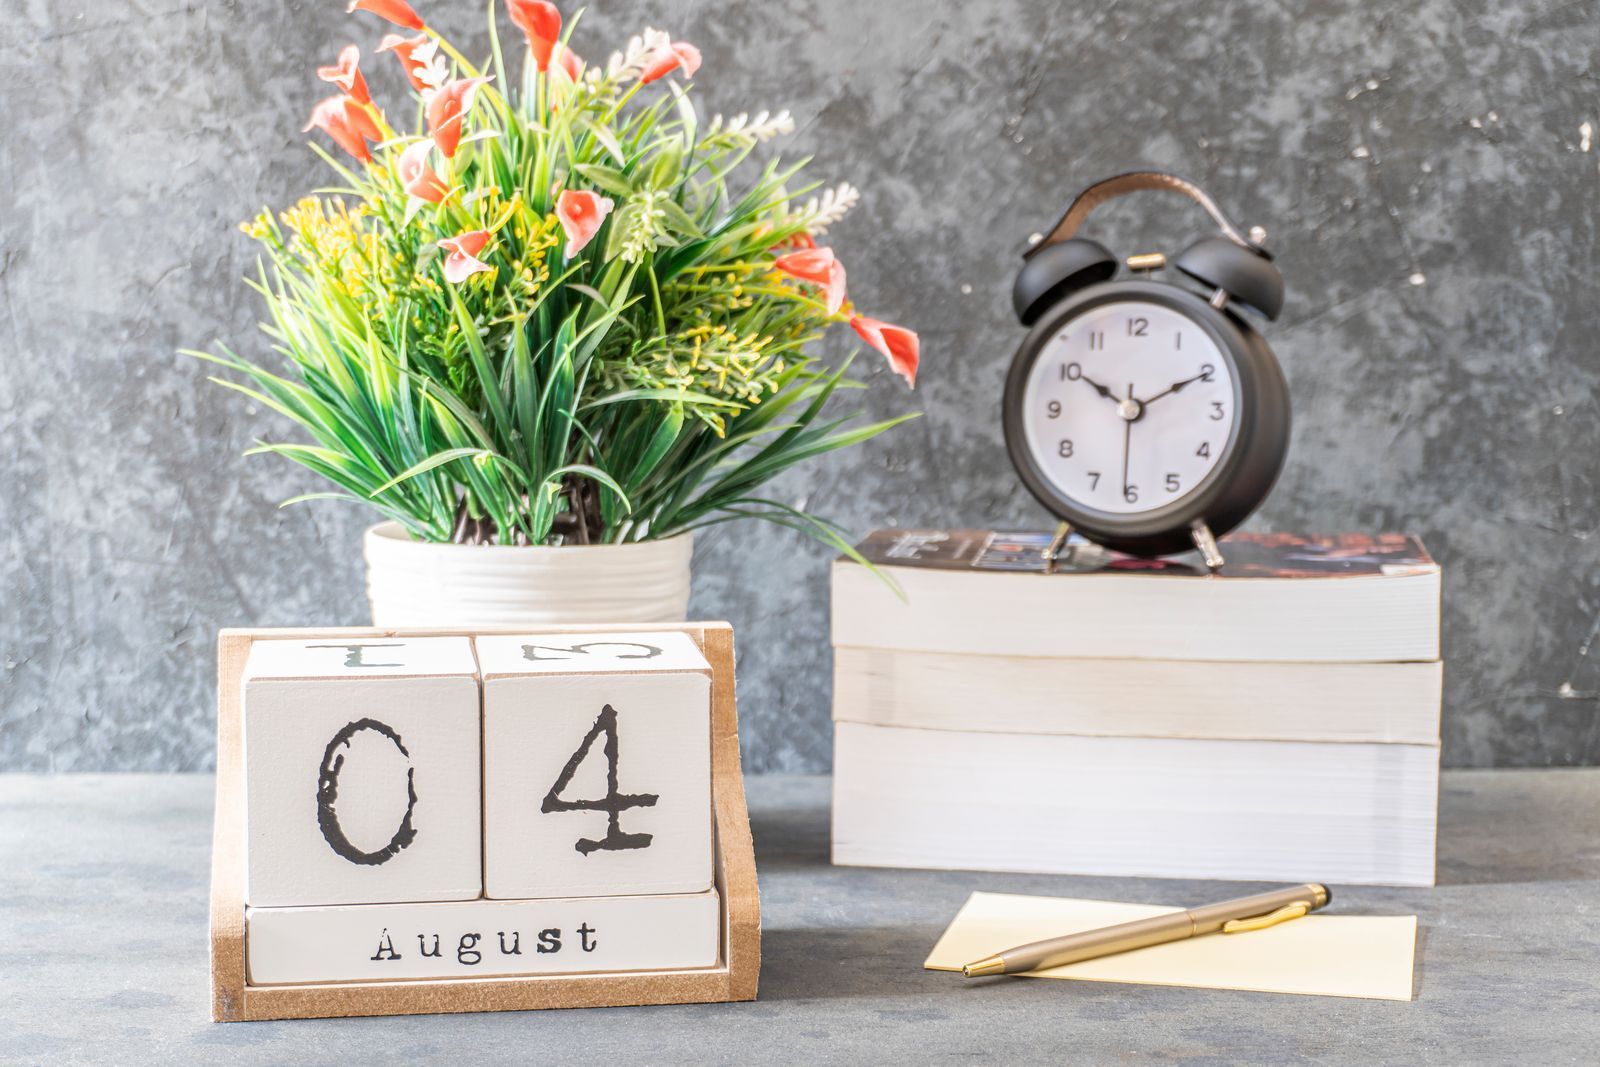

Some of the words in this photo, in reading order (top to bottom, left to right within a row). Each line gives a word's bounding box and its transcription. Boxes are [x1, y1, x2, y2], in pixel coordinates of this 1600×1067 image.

[1127, 317, 1149, 337] 12
[1089, 330, 1104, 350] 11
[1175, 331, 1182, 350] 1
[1059, 361, 1083, 382] 10
[1200, 363, 1215, 382] 2
[1047, 400, 1062, 420] 9
[1210, 401, 1225, 421] 3
[1058, 439, 1074, 459] 8
[1195, 441, 1211, 460] 4
[1087, 471, 1101, 491] 7
[1165, 473, 1180, 493] 5
[1126, 485, 1139, 504] 6
[520, 642, 664, 662] 3
[316, 717, 418, 866] 0
[540, 703, 660, 857] 4
[370, 921, 598, 966] August
